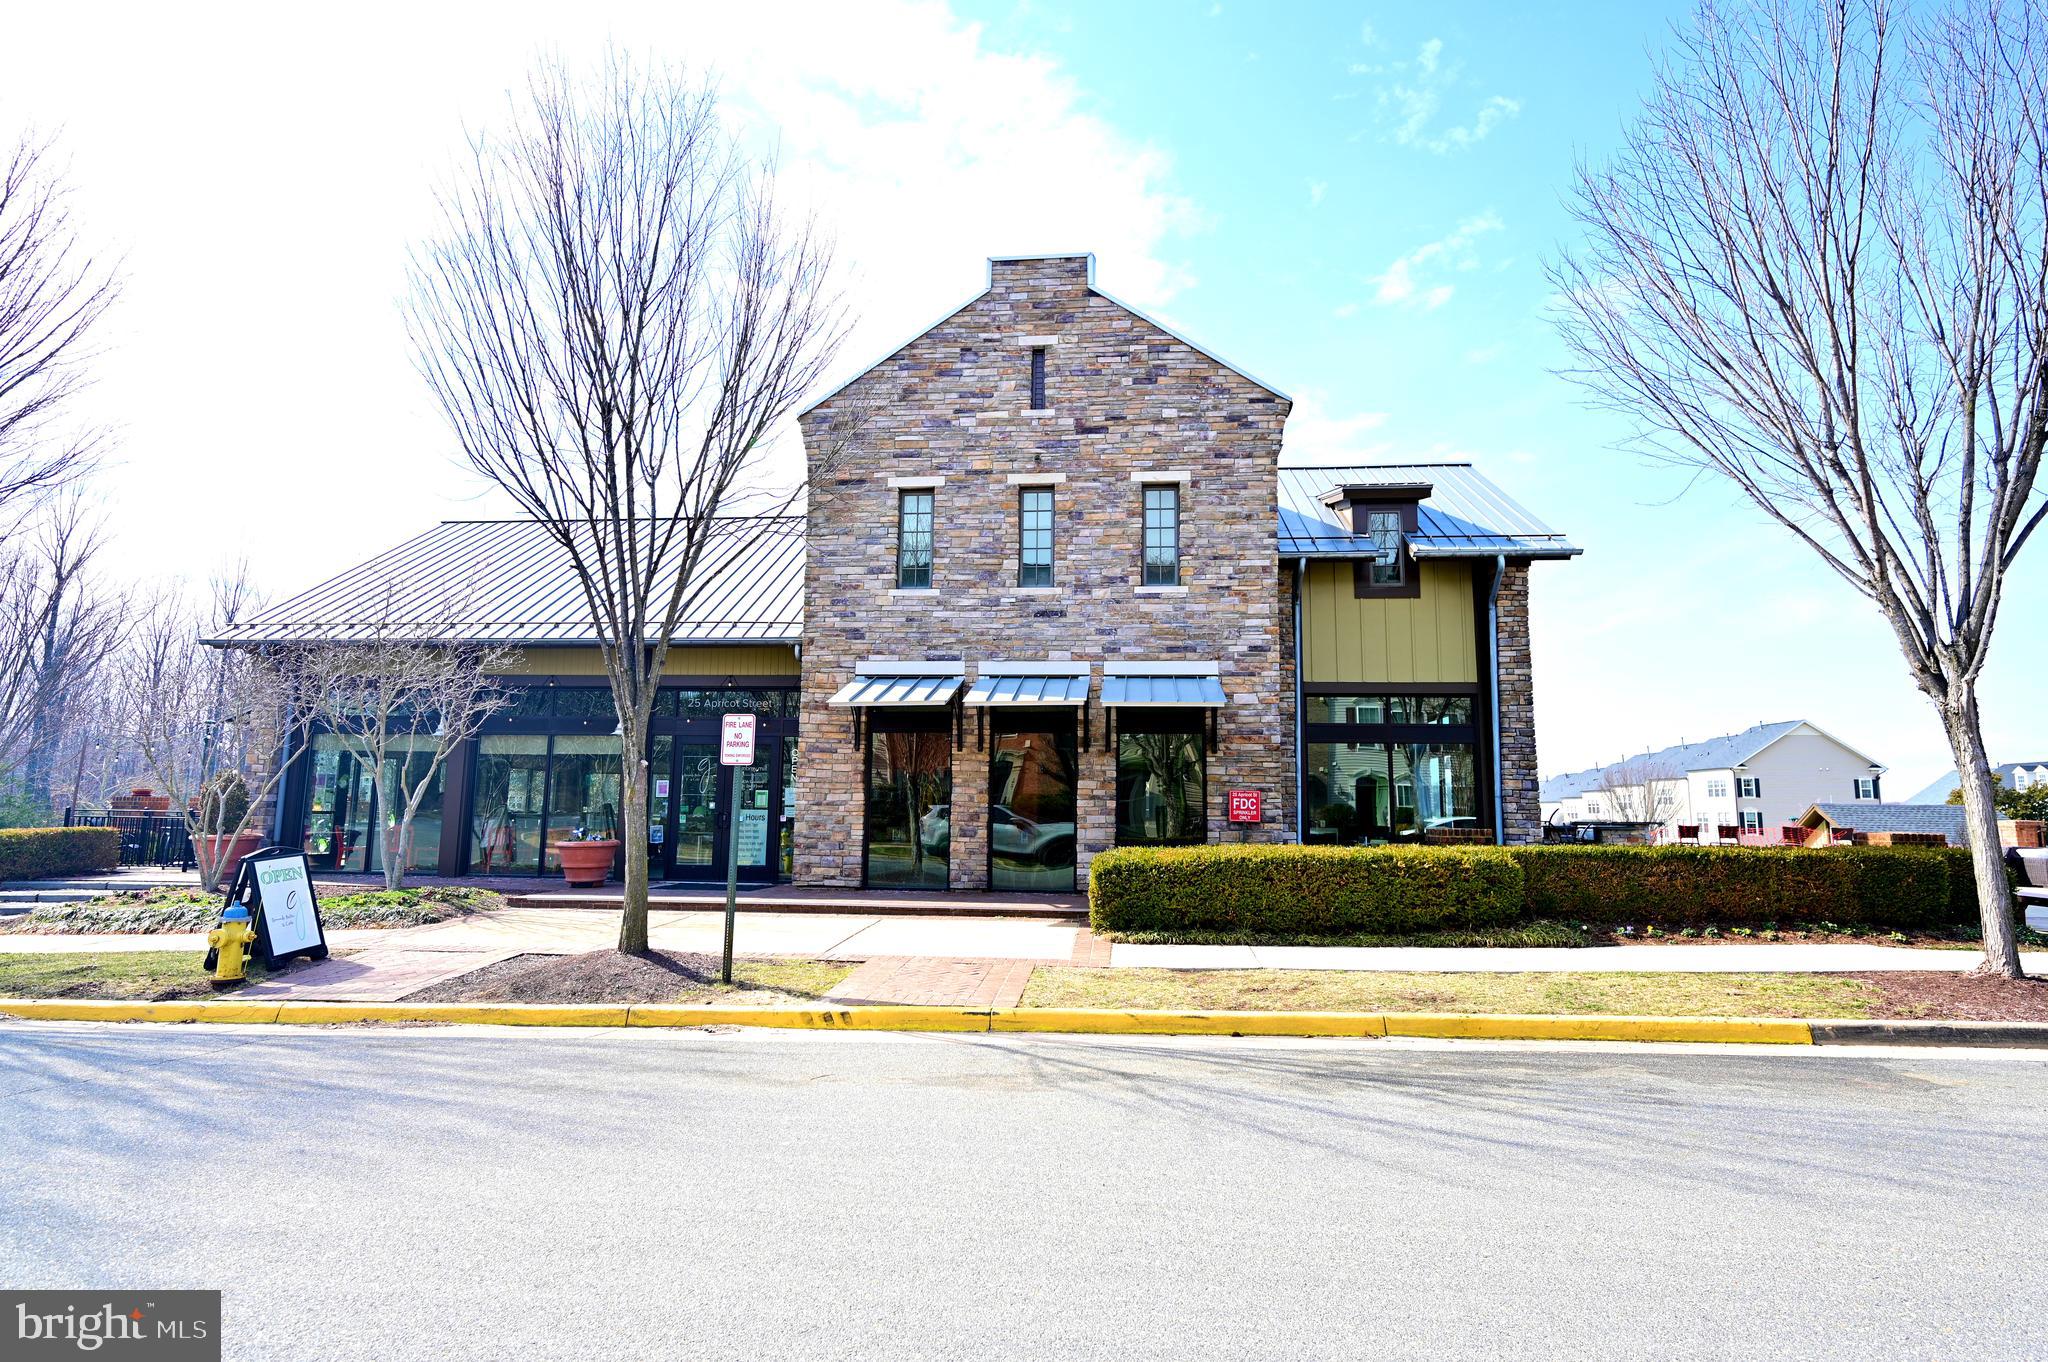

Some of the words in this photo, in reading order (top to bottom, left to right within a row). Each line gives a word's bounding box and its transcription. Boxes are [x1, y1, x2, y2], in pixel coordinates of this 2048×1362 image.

[688, 699, 701, 708] 25
[704, 699, 740, 710] Apricot
[742, 699, 772, 708] Street
[1233, 798, 1257, 810] FDC
[745, 813, 766, 821] Hours
[260, 866, 304, 885] OPEN
